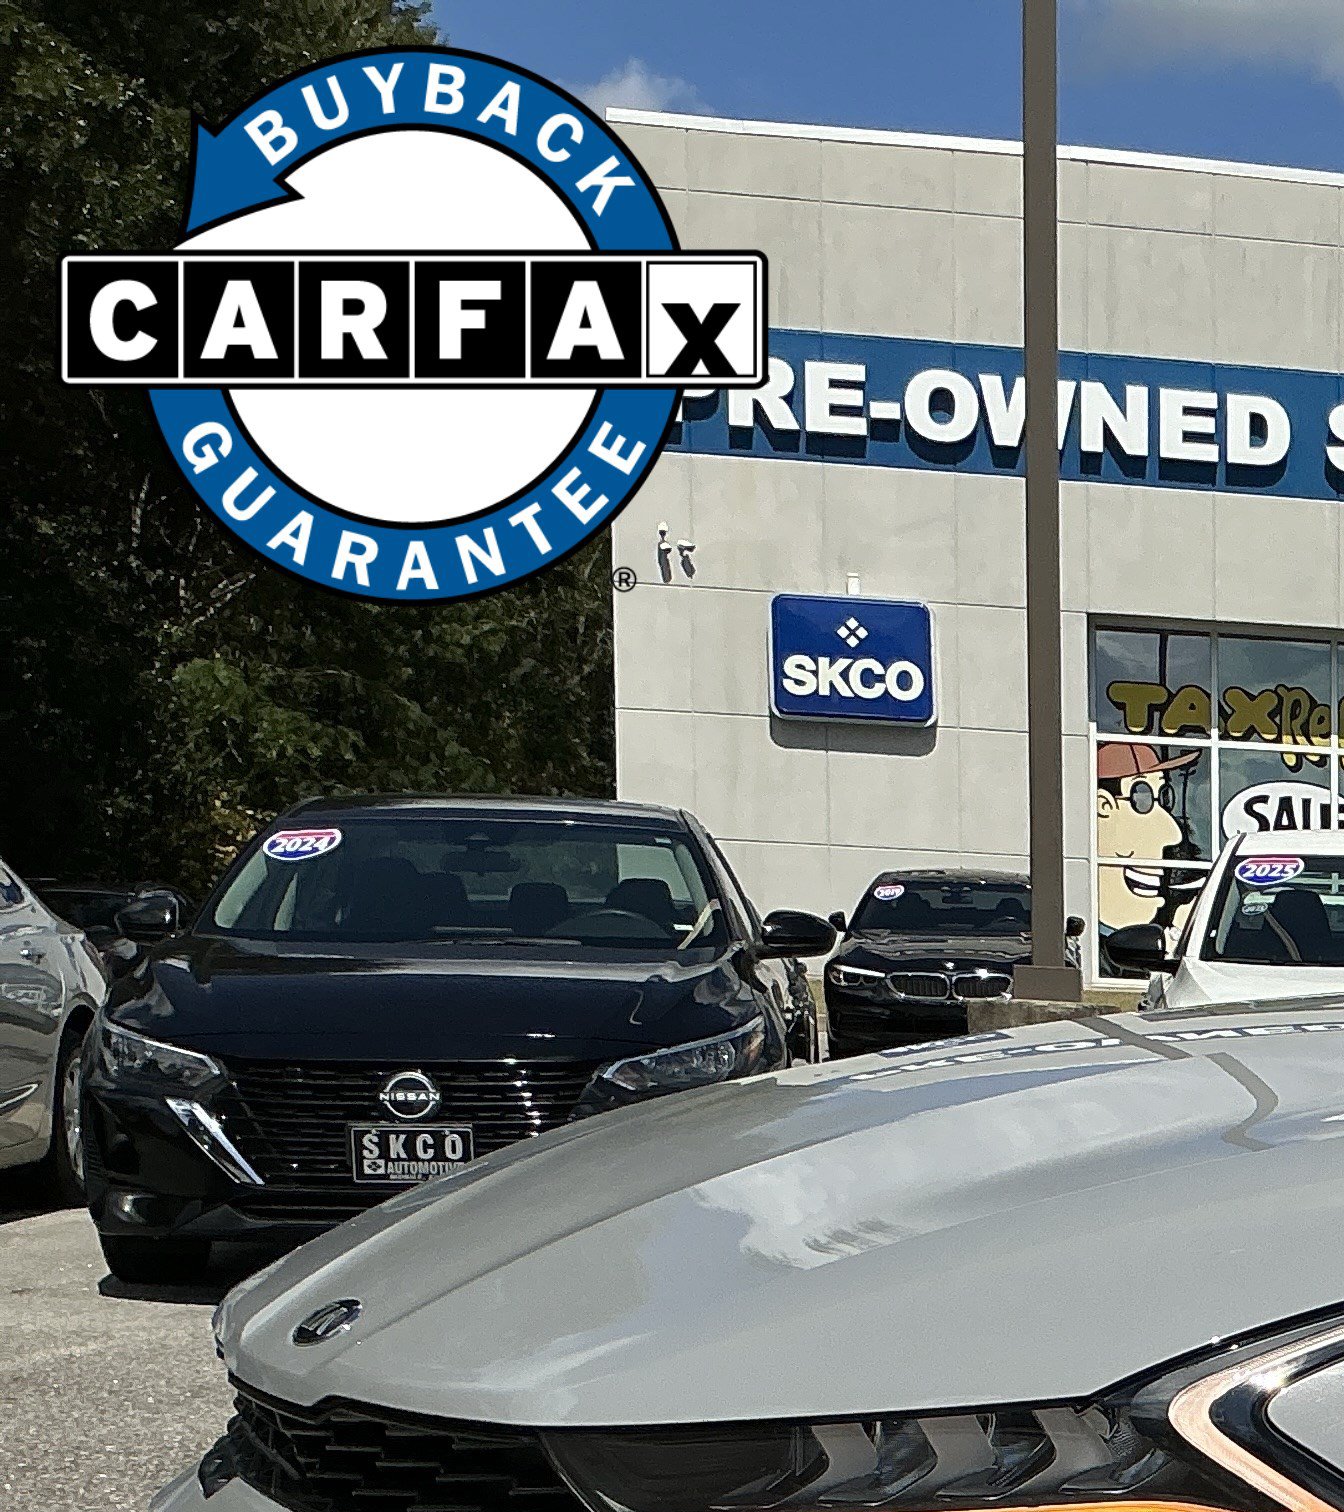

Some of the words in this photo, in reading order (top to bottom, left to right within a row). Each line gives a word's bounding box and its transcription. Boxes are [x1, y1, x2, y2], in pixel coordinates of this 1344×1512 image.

[782, 654, 925, 701] SKCO
[1105, 680, 1281, 743] TAX
[270, 836, 331, 853] 2024
[1242, 864, 1297, 877] 2025
[379, 1092, 441, 1101] NISSAN
[362, 1133, 464, 1160] SKCO
